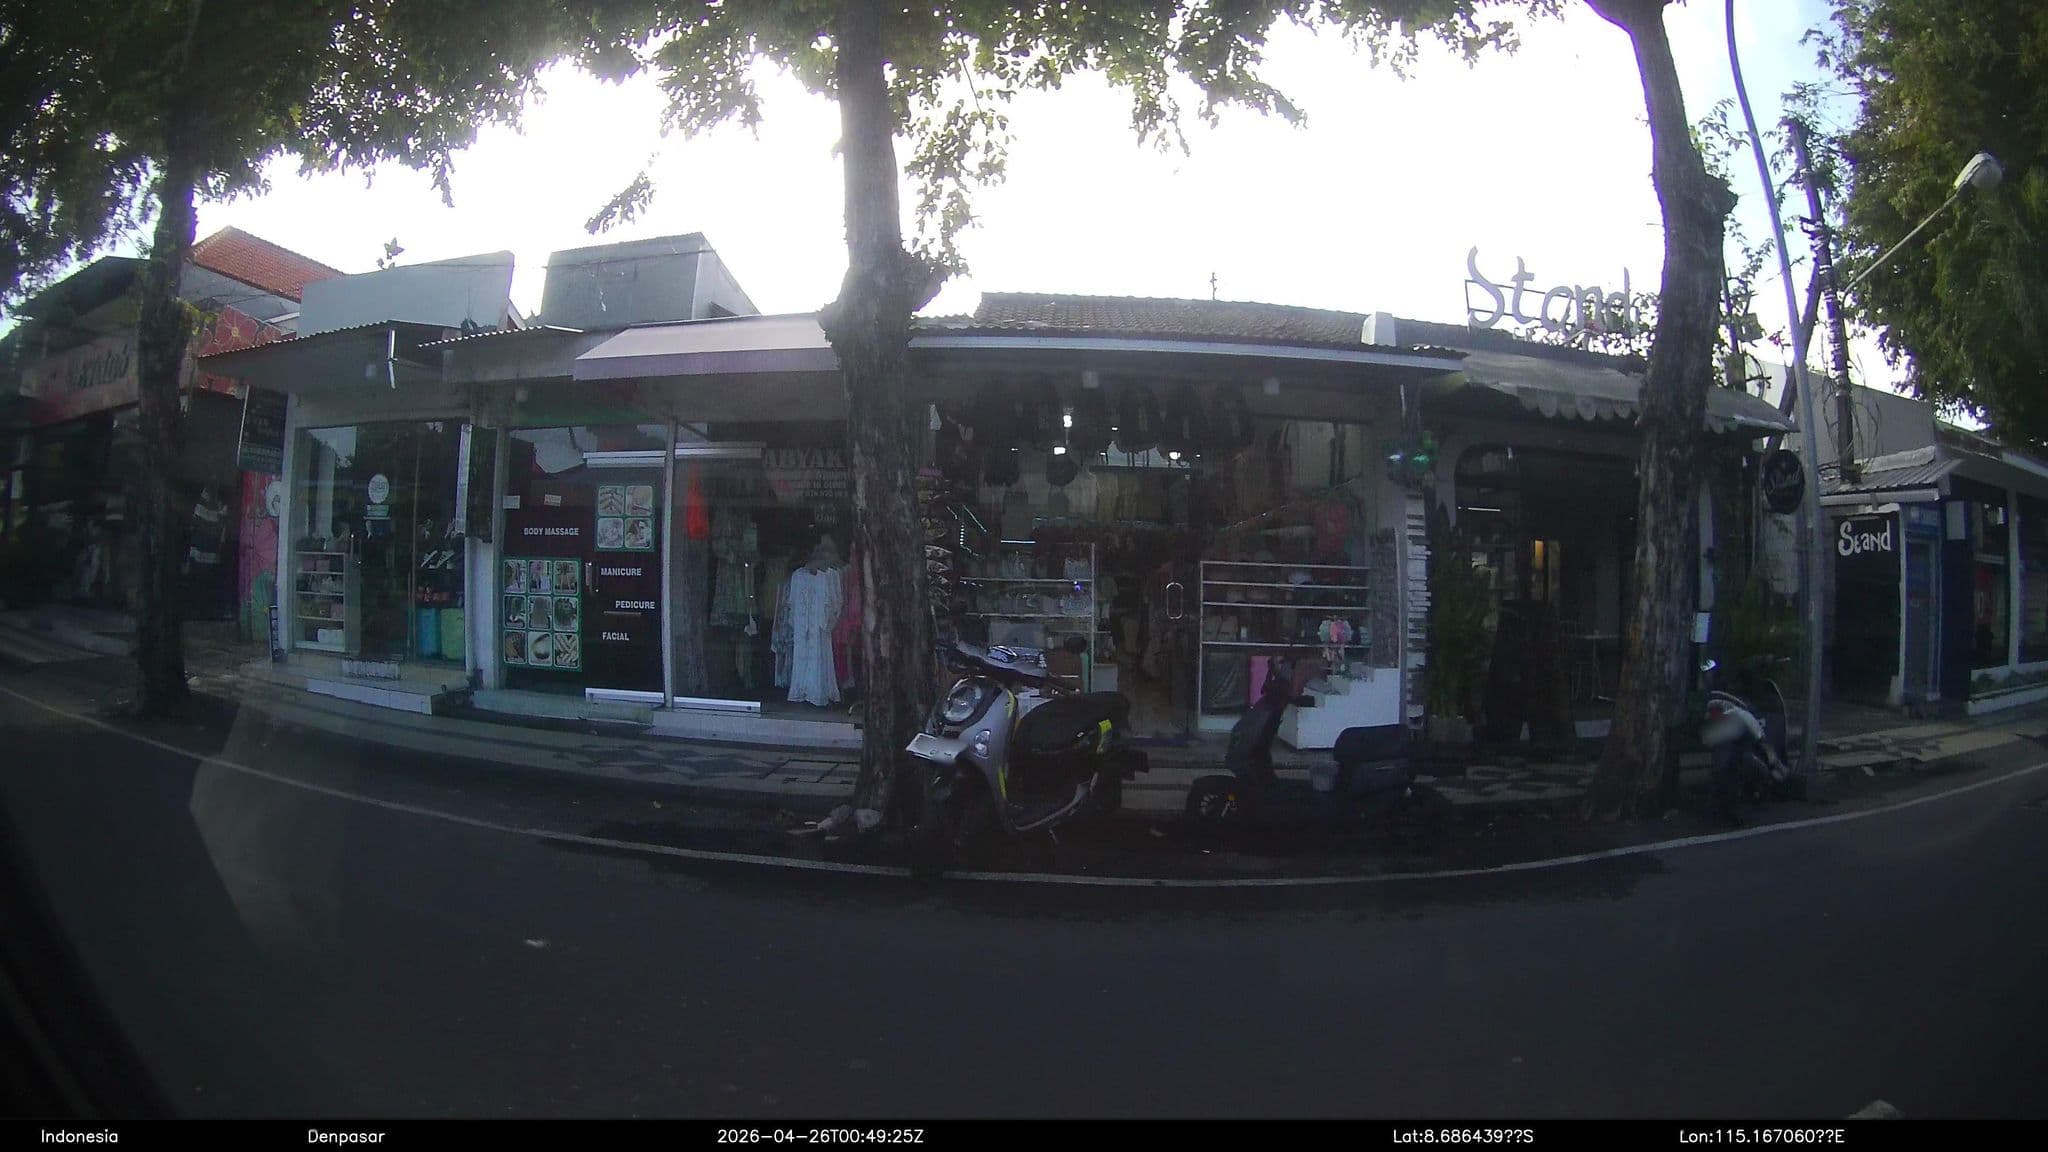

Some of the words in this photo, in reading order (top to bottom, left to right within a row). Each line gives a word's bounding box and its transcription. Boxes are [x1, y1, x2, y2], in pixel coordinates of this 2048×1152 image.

[523, 527, 544, 536] BODY
[544, 527, 580, 536] MASSAGE
[600, 567, 642, 577] MANICURE
[615, 600, 656, 610] PEDICURE
[602, 631, 630, 641] FACIAL
